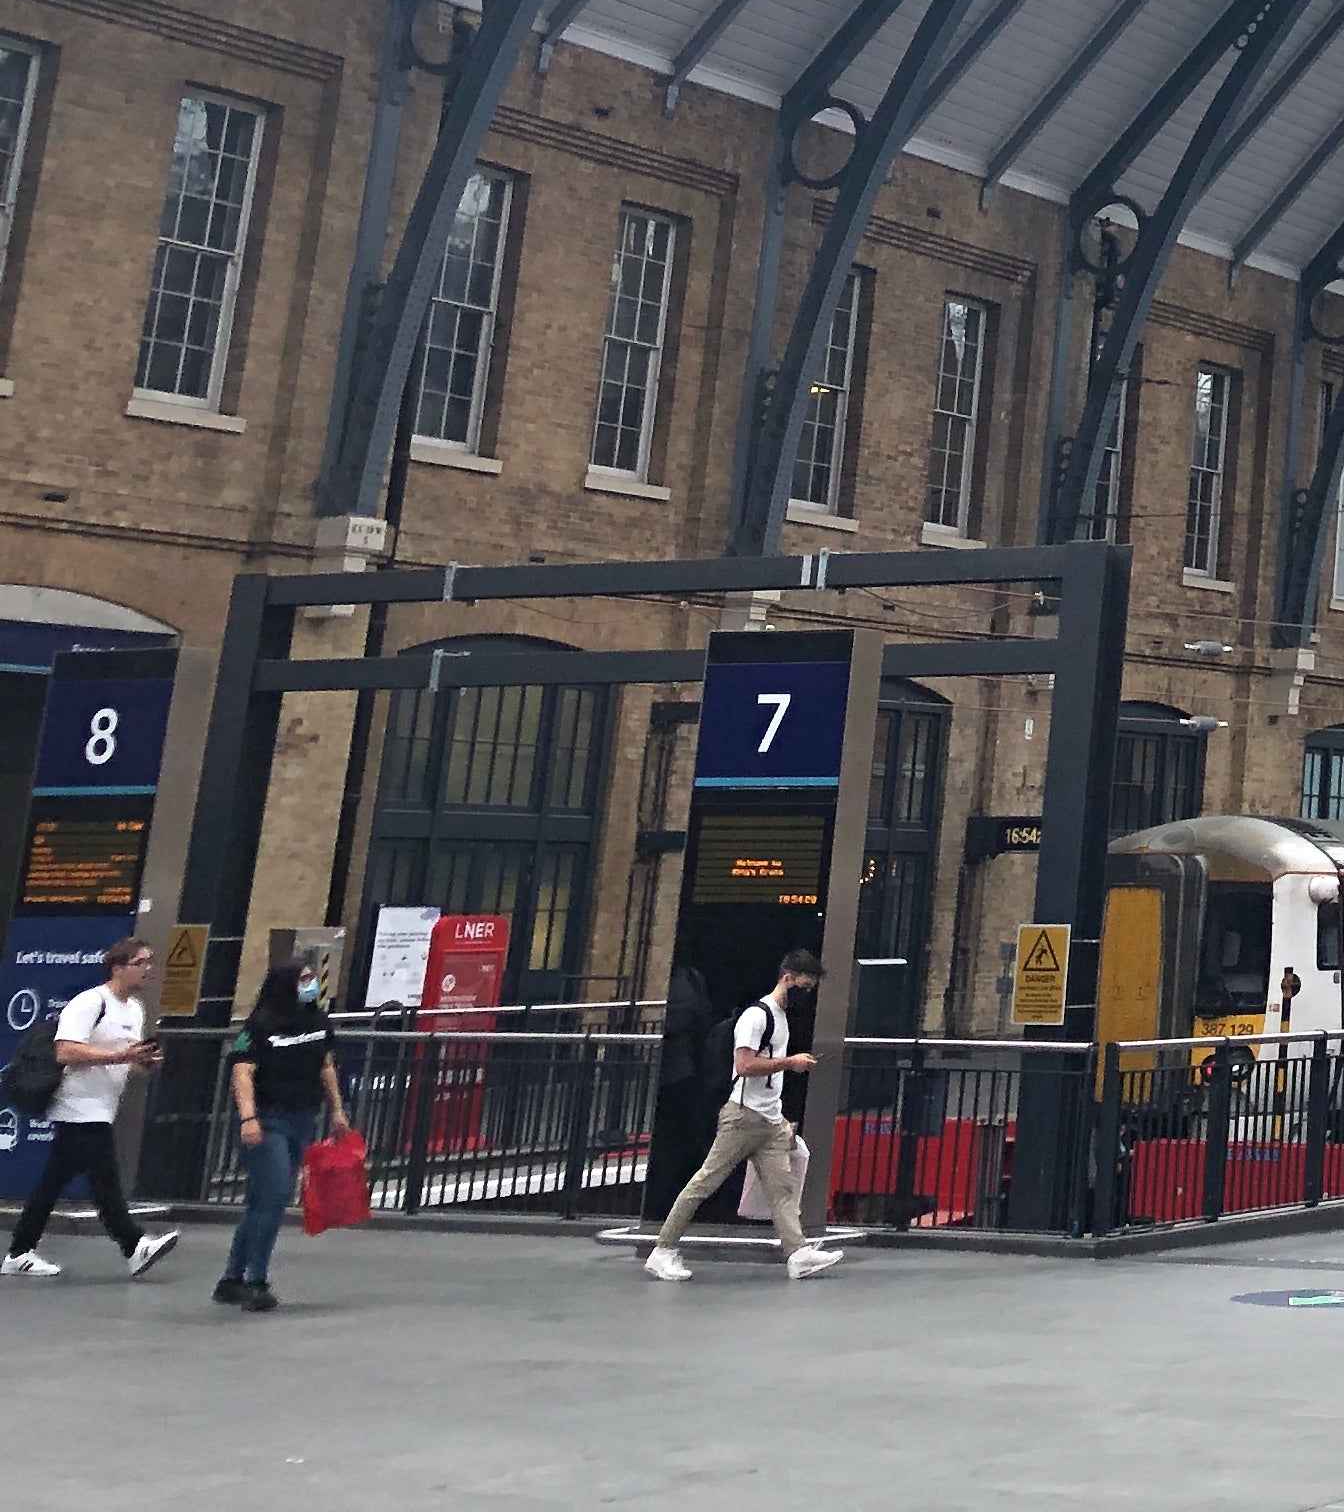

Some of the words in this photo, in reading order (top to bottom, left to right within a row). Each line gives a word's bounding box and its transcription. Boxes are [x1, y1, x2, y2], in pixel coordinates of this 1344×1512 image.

[757, 693, 791, 753] 7
[85, 707, 118, 765] 8
[455, 921, 495, 939] LNER
[16, 951, 44, 964] Let's
[45, 950, 81, 964] travel
[1201, 1023, 1226, 1036] 387
[1230, 1024, 1254, 1035] 129
